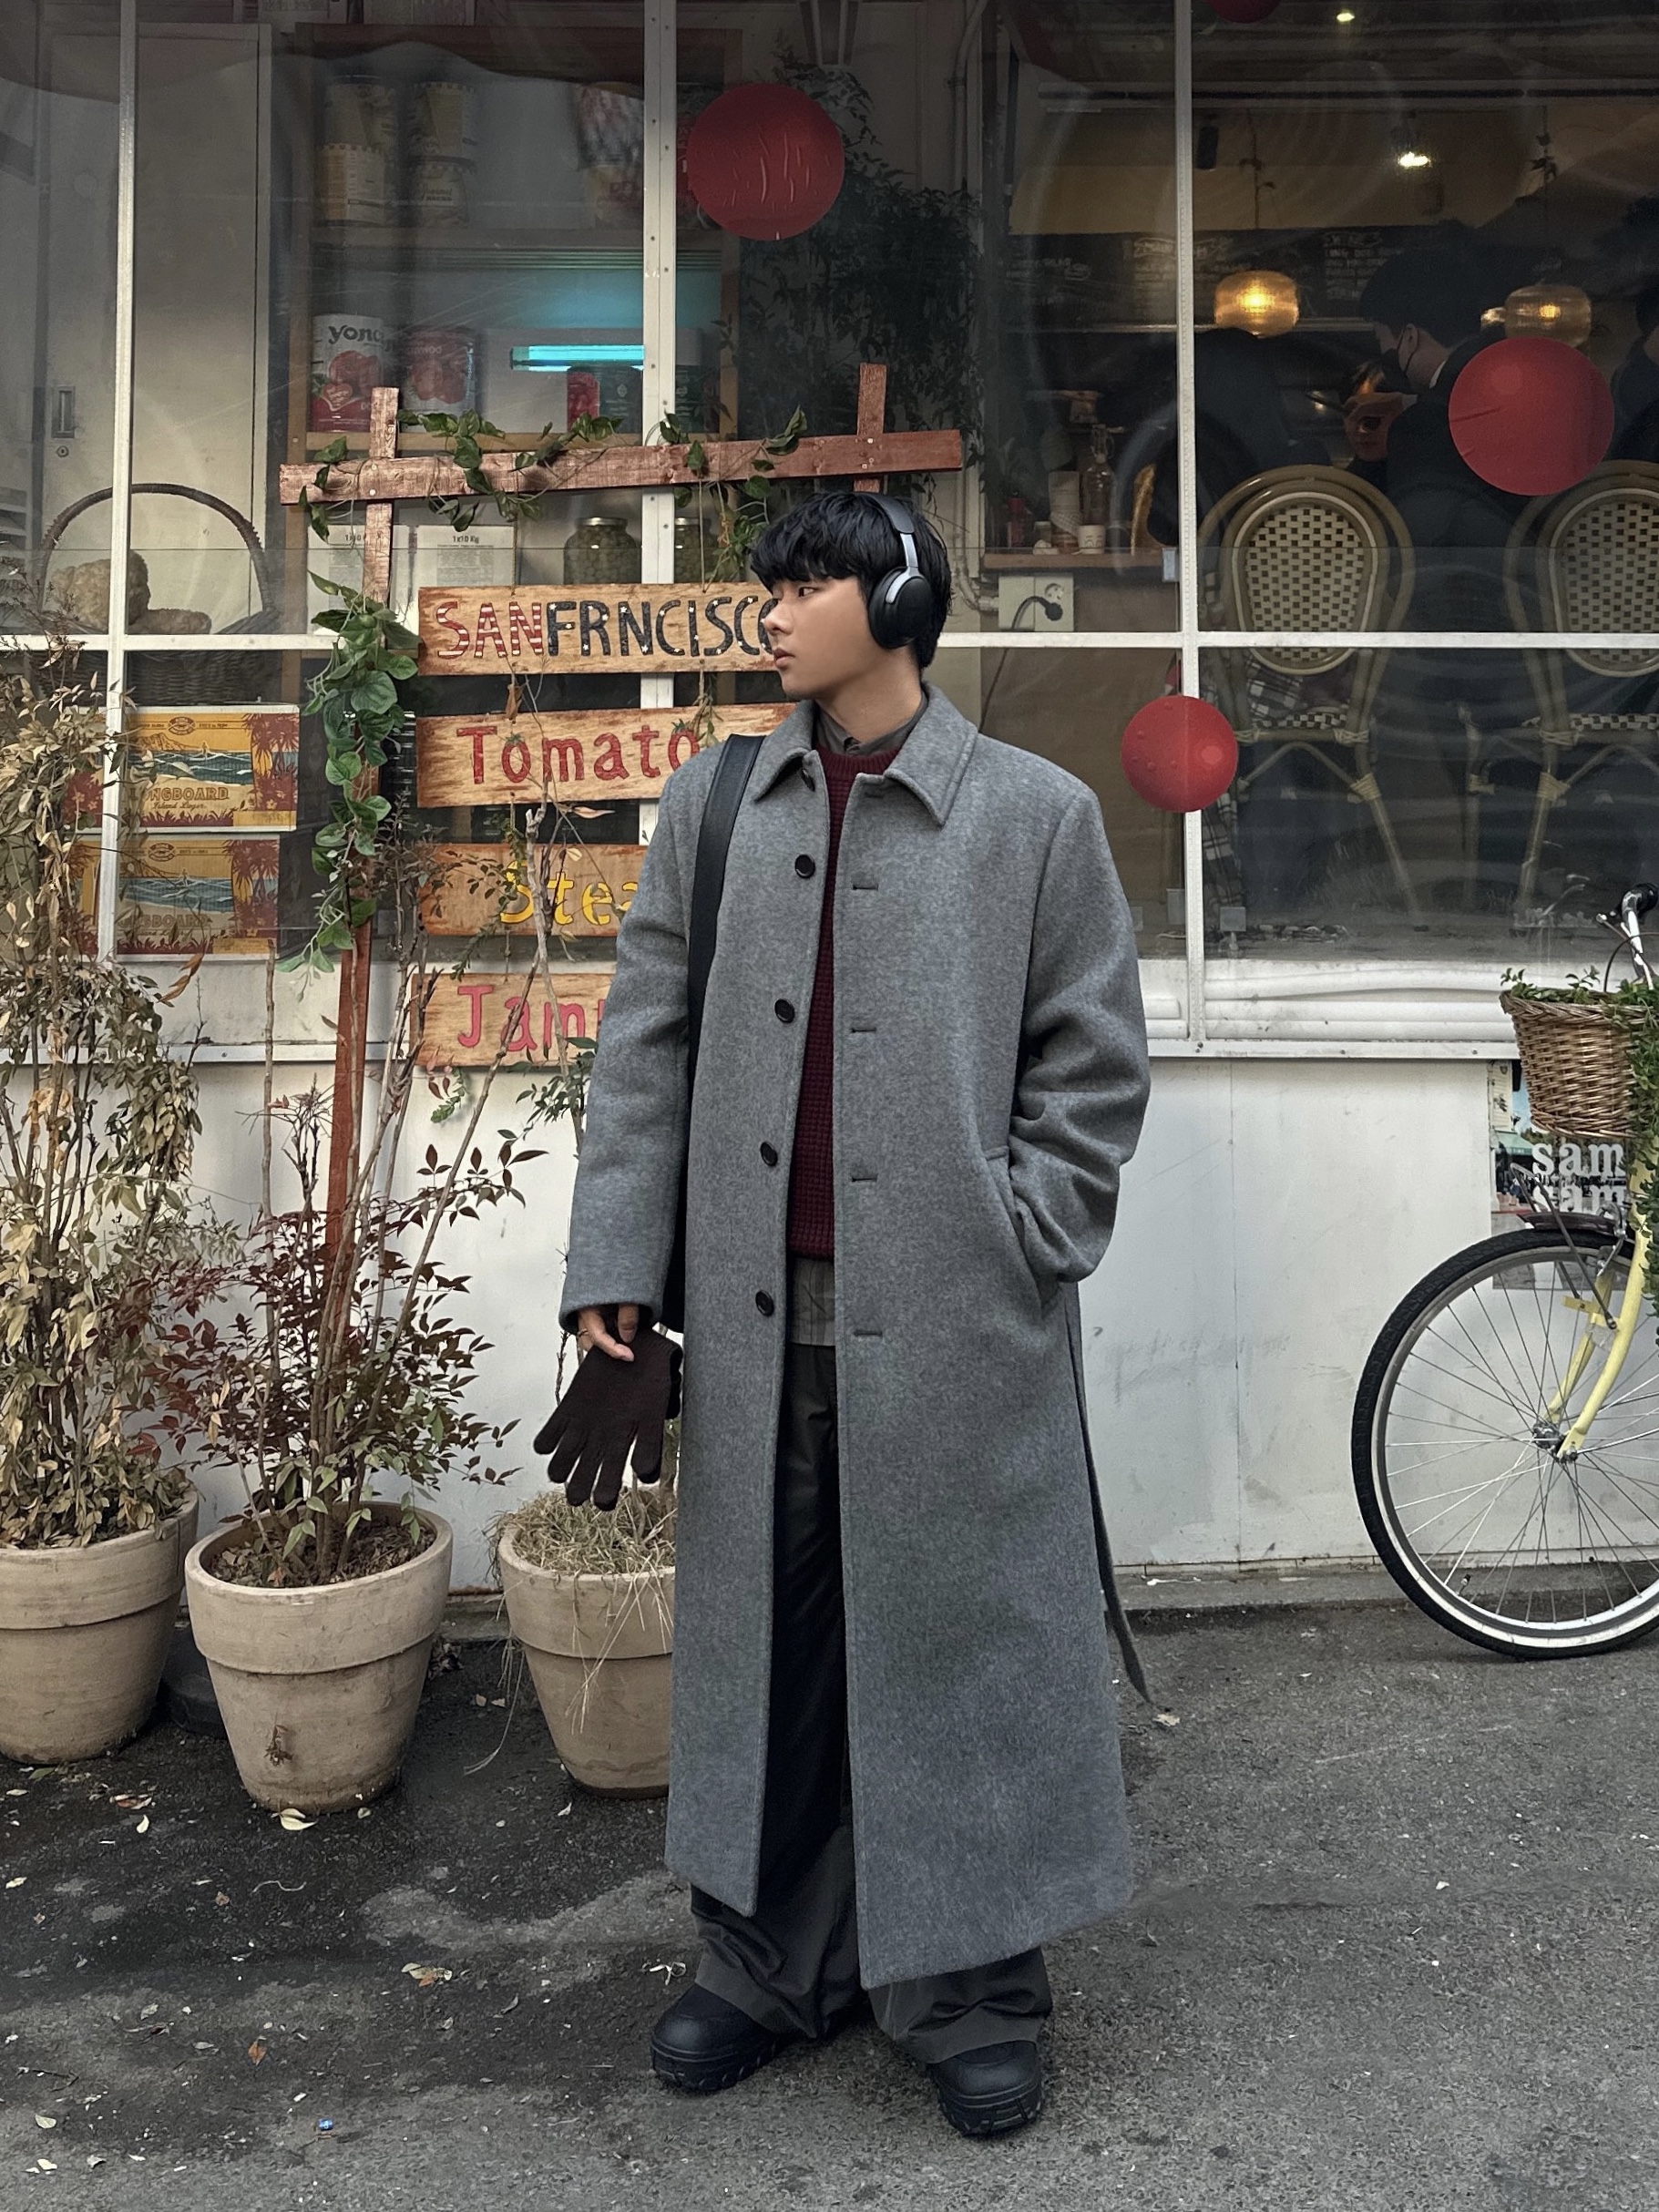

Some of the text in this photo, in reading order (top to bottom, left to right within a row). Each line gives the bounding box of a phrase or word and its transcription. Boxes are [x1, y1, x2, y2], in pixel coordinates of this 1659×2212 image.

[456, 722, 700, 785] Tomato
[456, 985, 606, 1051] Jam
[1531, 1142, 1627, 1176] sam
